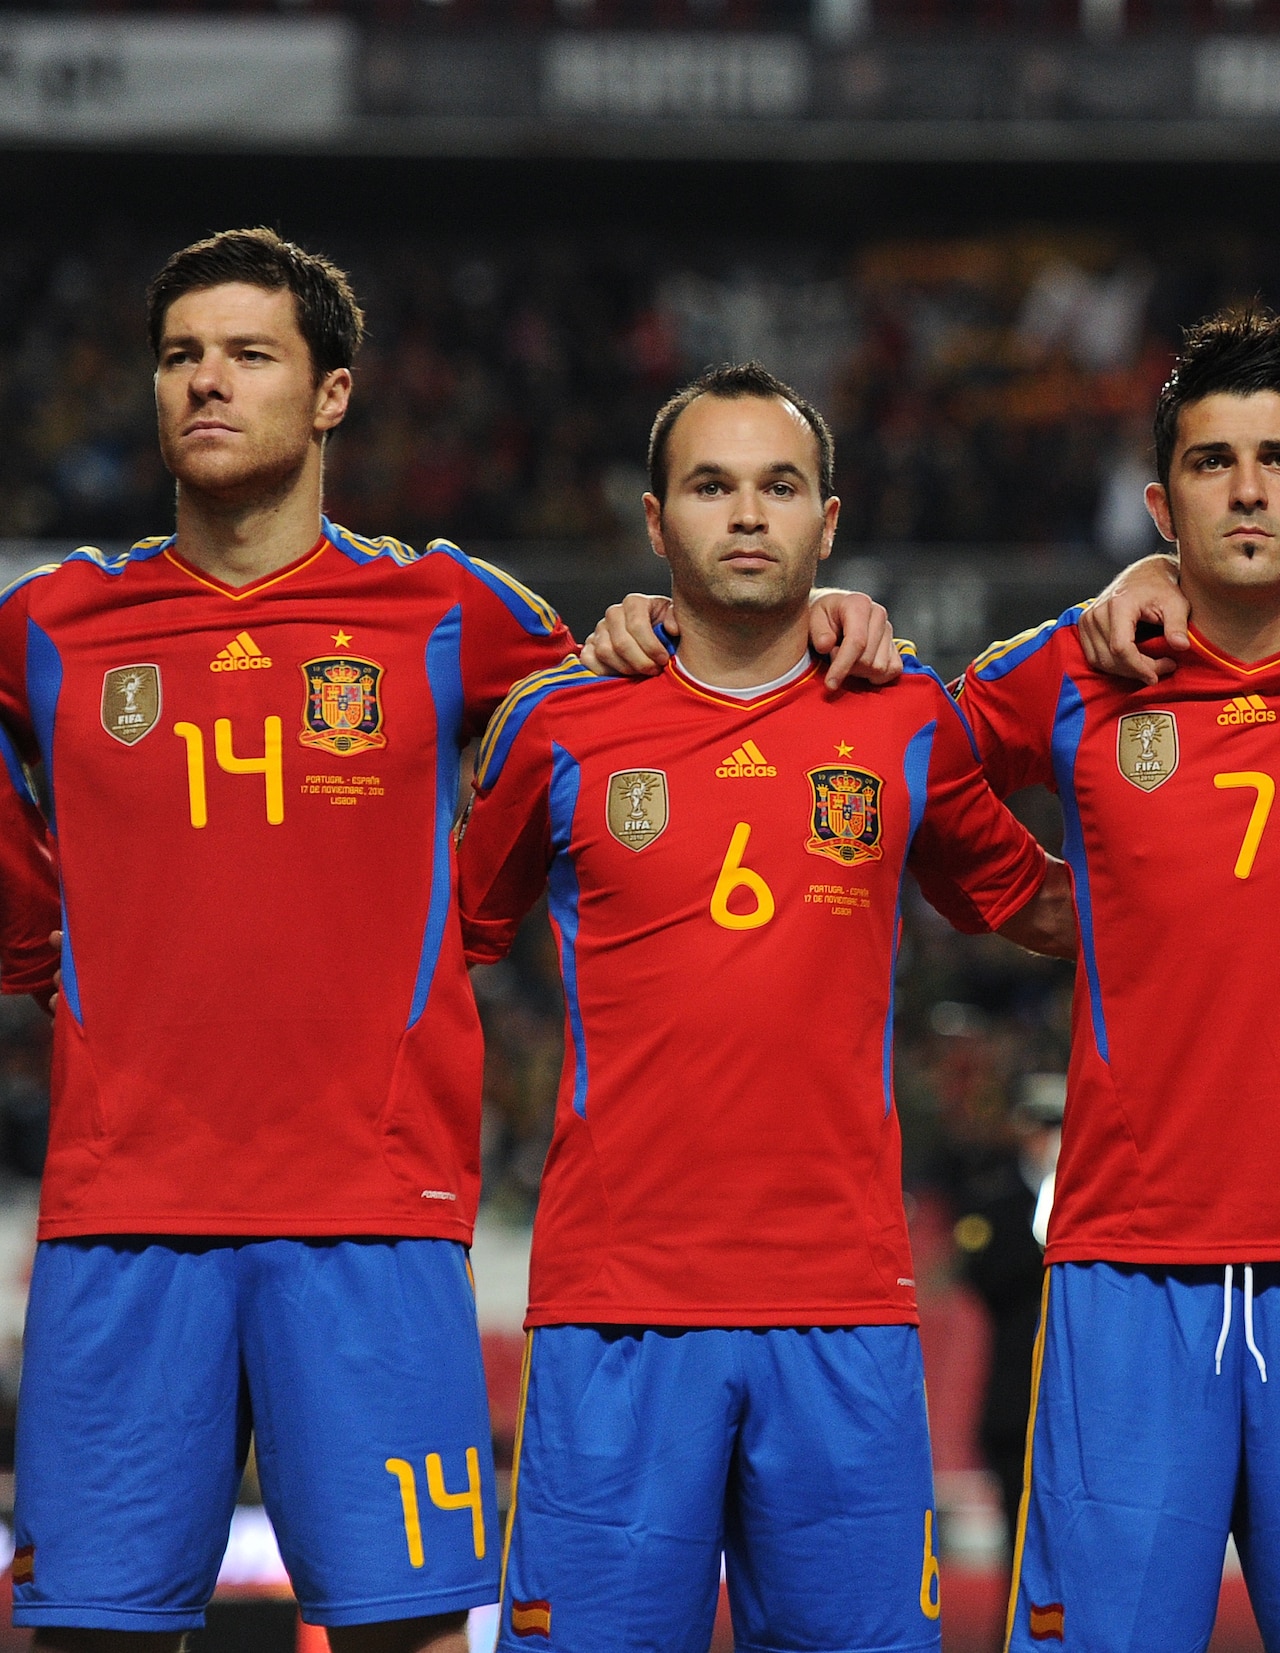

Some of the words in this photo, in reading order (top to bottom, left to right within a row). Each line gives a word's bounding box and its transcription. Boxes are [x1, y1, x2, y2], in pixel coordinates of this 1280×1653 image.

[209, 655, 272, 673] adidas
[118, 713, 144, 725] FIFA
[1216, 709, 1277, 726] adidas
[173, 715, 284, 829] 14
[715, 763, 778, 779] adidas
[1135, 761, 1161, 771] FIFA
[305, 775, 345, 784] PORTUGAL
[351, 776, 380, 785] ESPAÑA
[300, 785, 308, 794] 17
[309, 785, 320, 794] DE
[368, 787, 385, 796] 2010
[330, 796, 357, 805] LISBOA
[624, 820, 650, 830] FIFA
[1213, 771, 1276, 880] 7
[710, 821, 775, 931] 6
[809, 885, 845, 895] PORTUGAL
[804, 894, 812, 903] 17
[813, 895, 823, 903] DE
[385, 1447, 486, 1568] 14
[920, 1509, 941, 1620] 6
